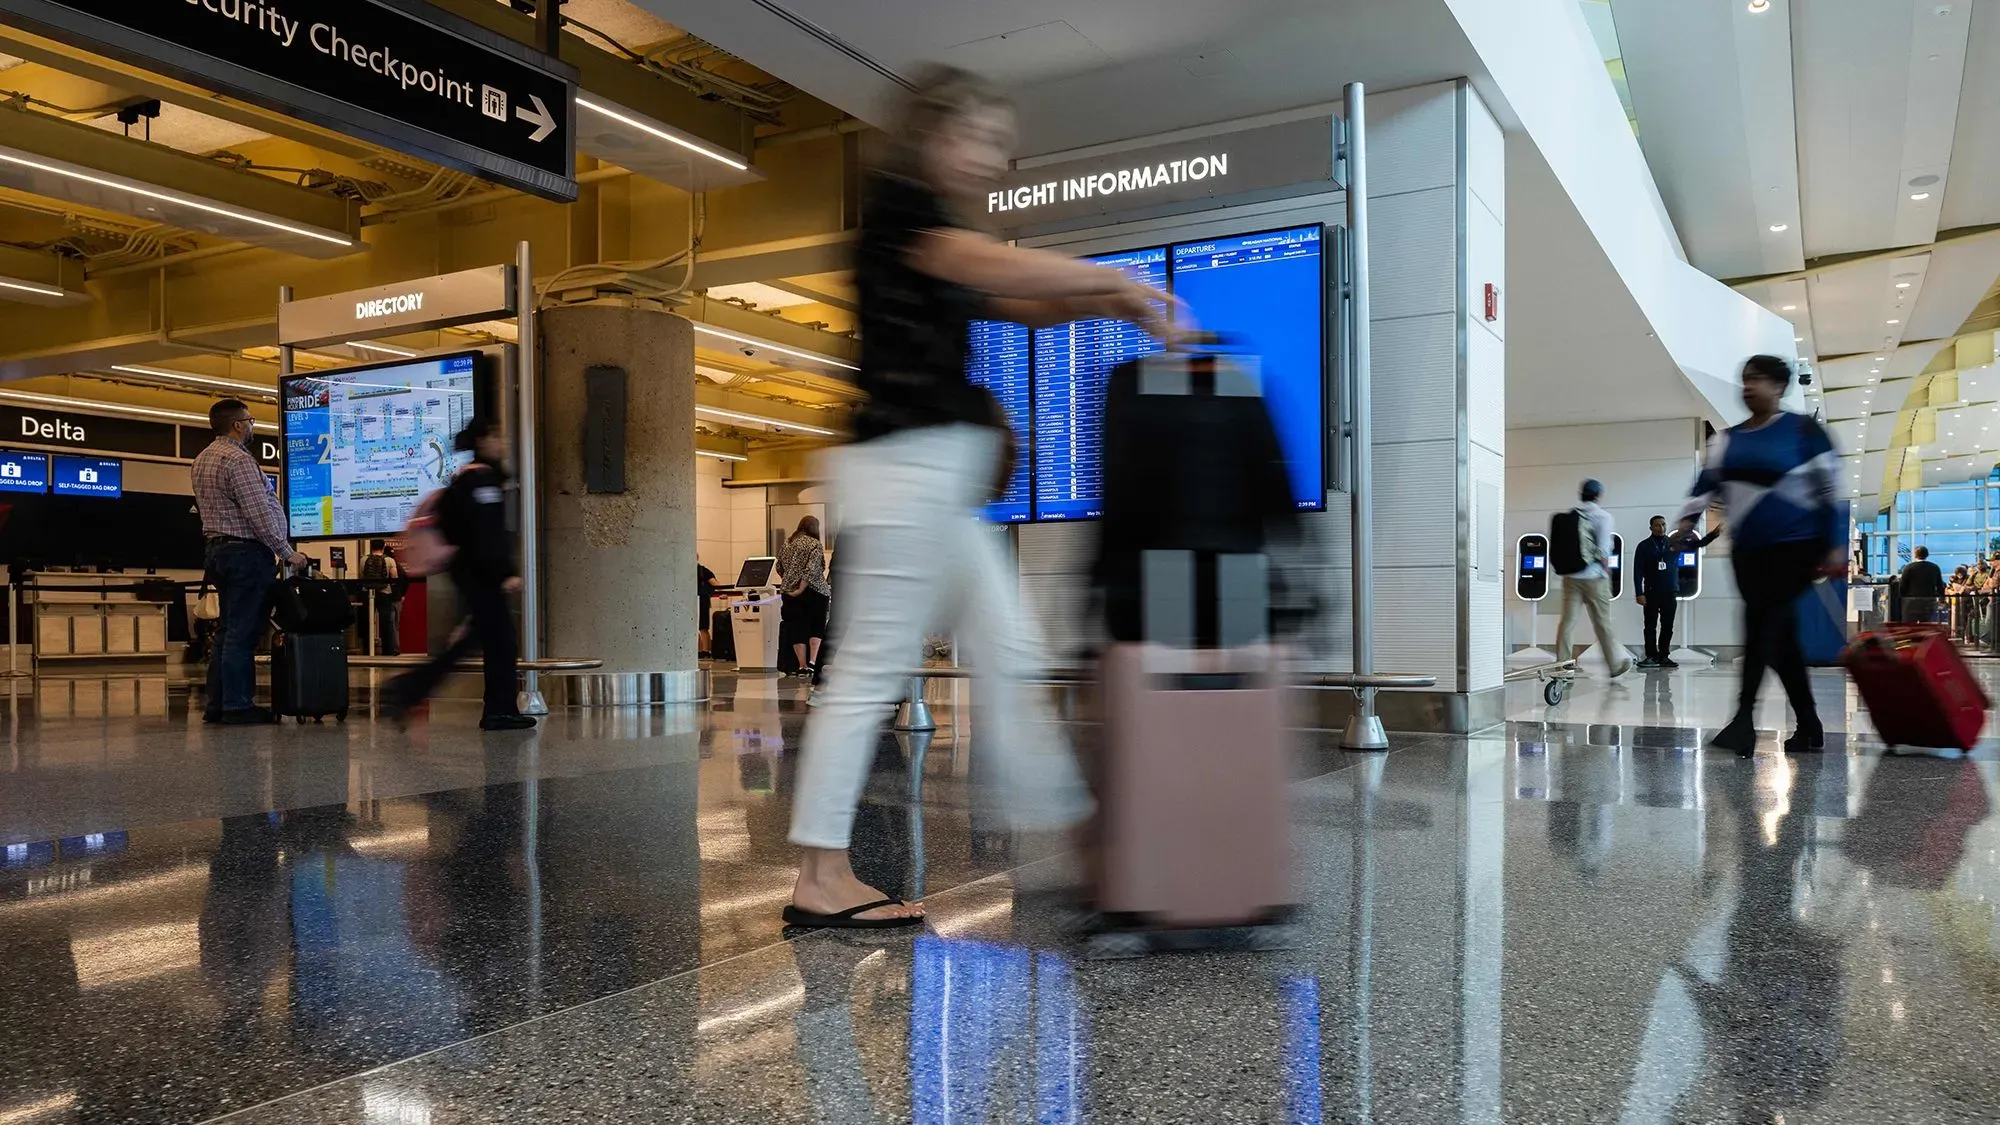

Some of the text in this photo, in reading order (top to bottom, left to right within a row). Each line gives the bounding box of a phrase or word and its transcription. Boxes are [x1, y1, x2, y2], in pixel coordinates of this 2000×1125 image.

[186, 0, 474, 108] curity Checkpoint
[988, 153, 1228, 213] FLIGHT INFORMATION
[1176, 244, 1216, 256] DEPARTURES
[356, 292, 424, 320] DIRECTORY
[299, 394, 320, 409] RIDE
[289, 413, 303, 421] LEVEL
[21, 416, 85, 442] Delta
[262, 442, 280, 460] D
[289, 438, 309, 448] LEVEL 2
[318, 433, 333, 464] 2
[290, 468, 306, 477] LEVEL
